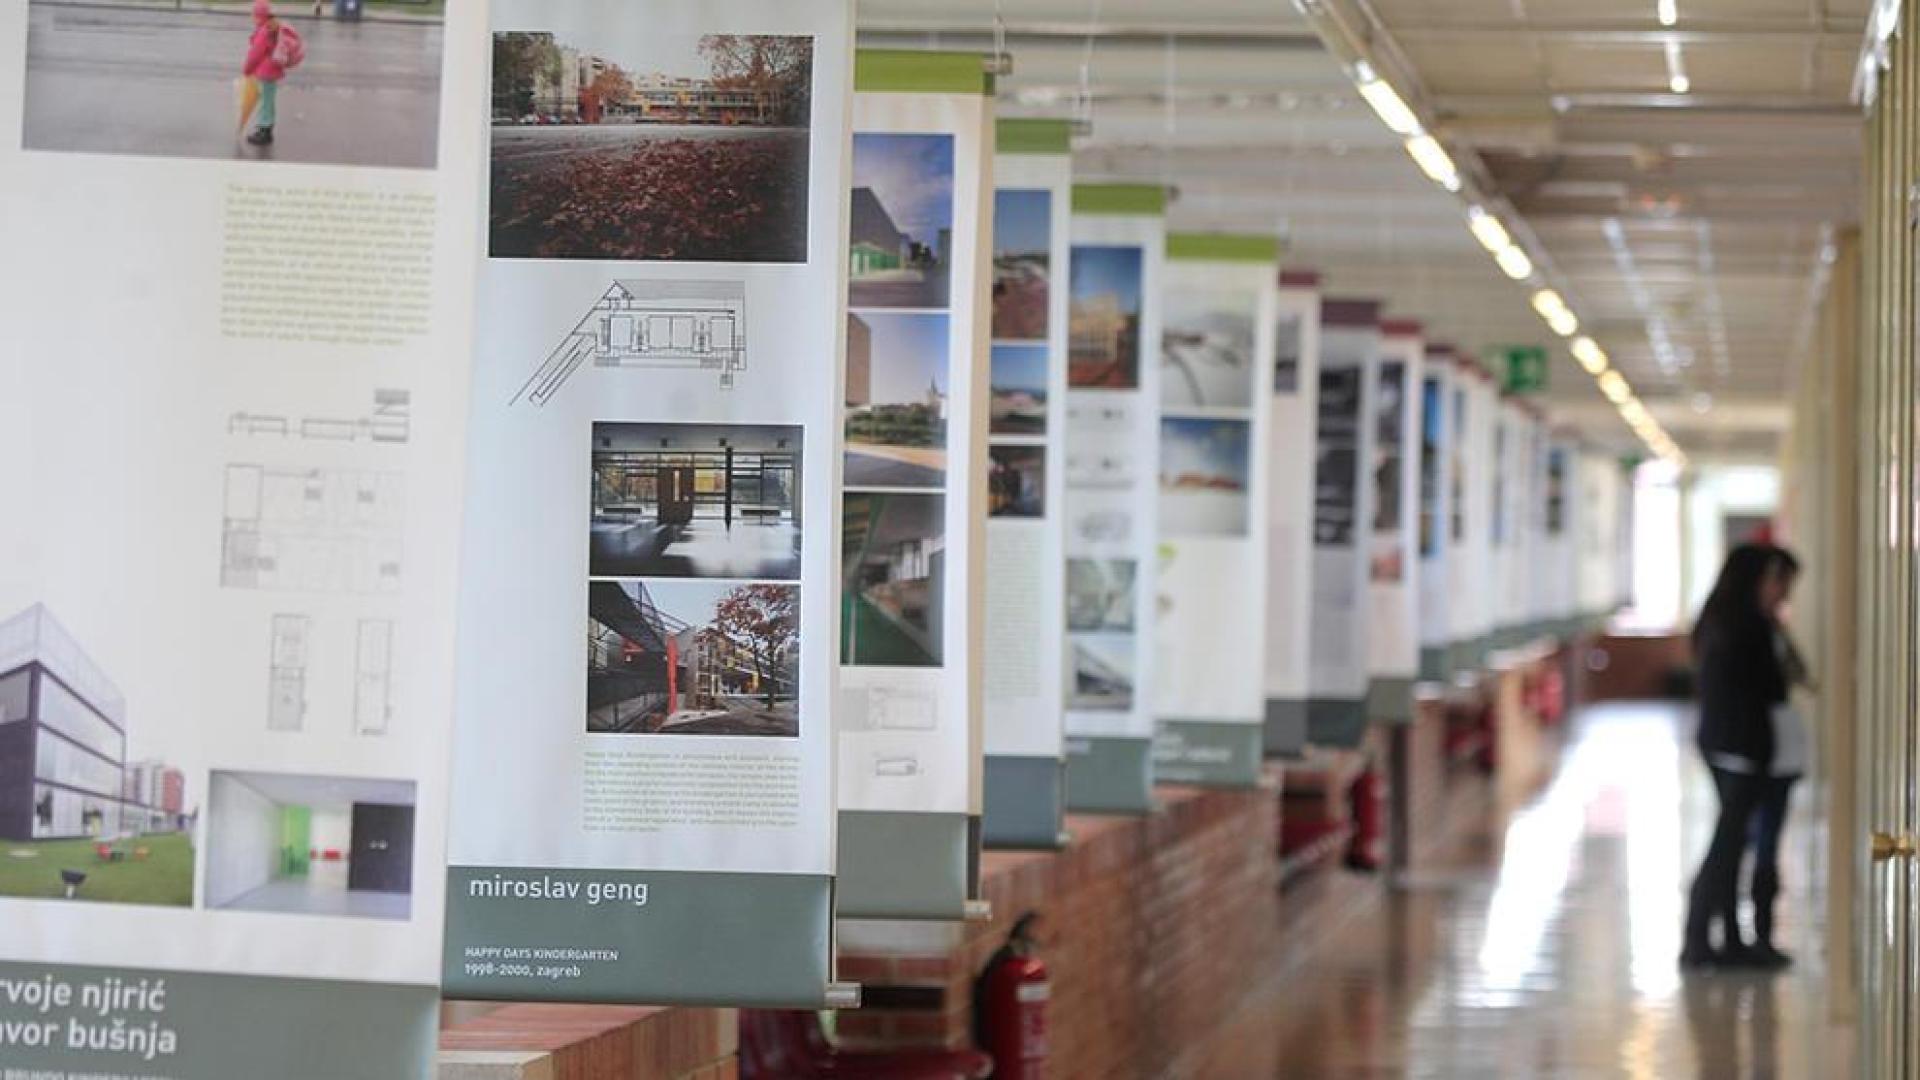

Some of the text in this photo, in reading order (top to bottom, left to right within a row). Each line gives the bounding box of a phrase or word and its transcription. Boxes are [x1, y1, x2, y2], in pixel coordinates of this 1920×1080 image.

[470, 874, 648, 905] miroslav geng
[465, 947, 619, 961] HAPPY DAYS KINDERGARTEN
[536, 965, 581, 979] zagreb
[82, 977, 166, 1016] njirić
[0, 1017, 177, 1060] vor bušnja
